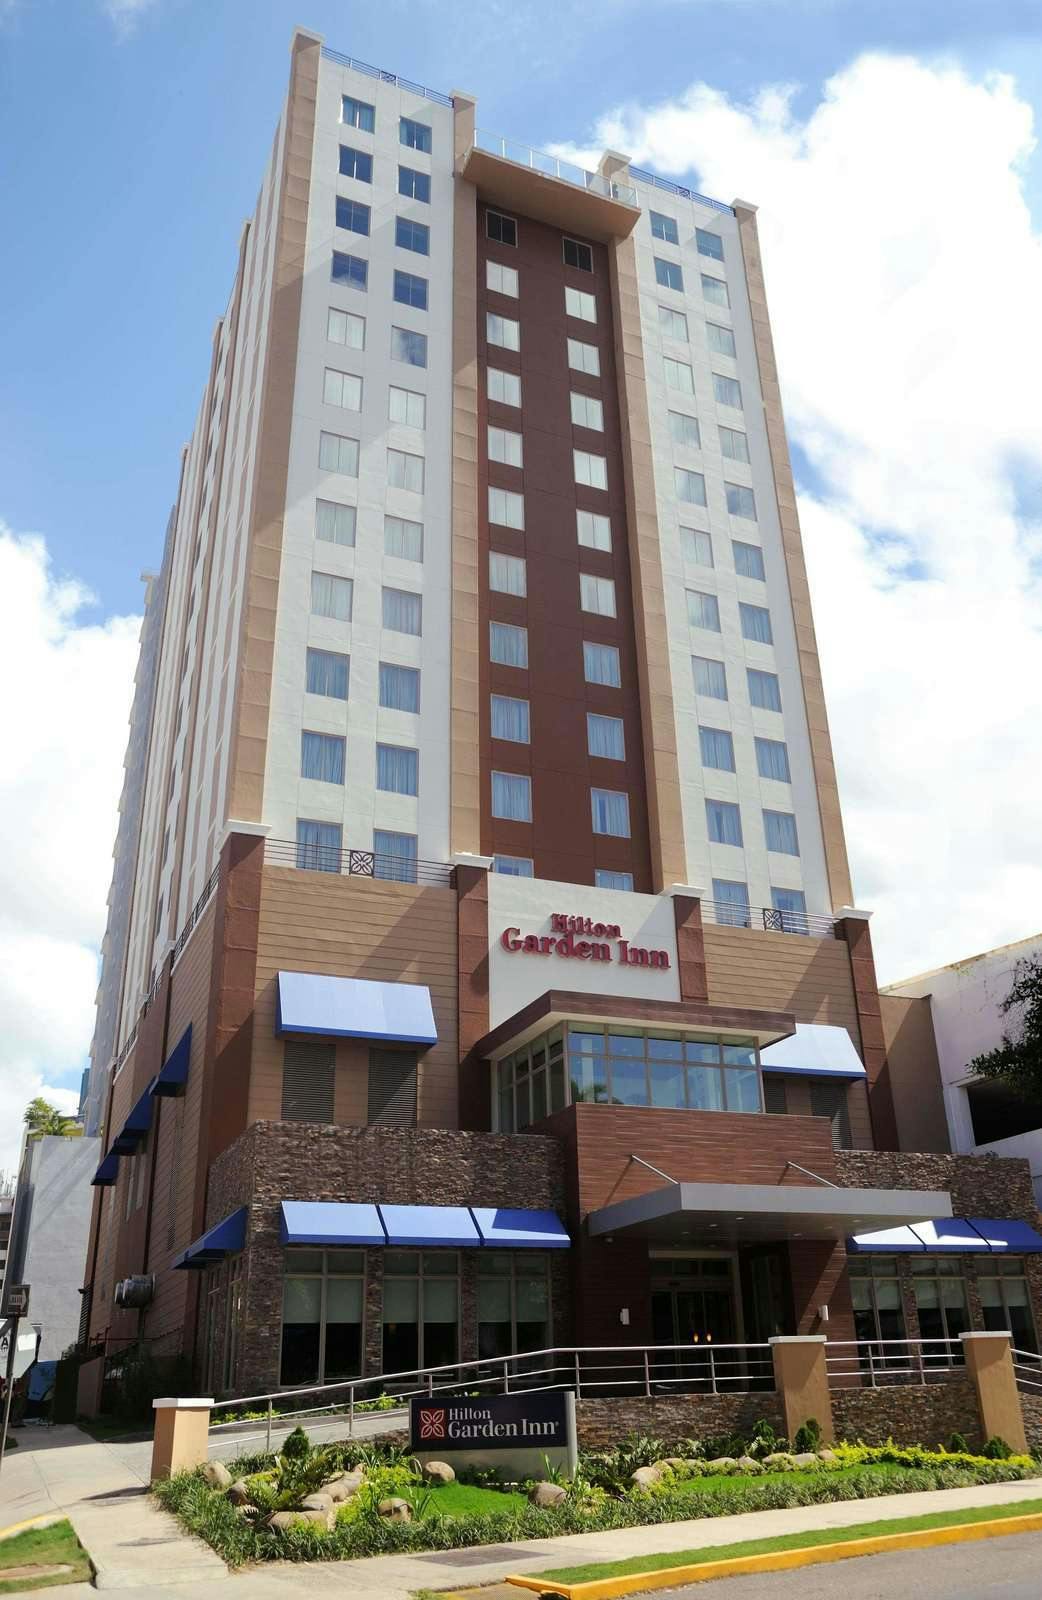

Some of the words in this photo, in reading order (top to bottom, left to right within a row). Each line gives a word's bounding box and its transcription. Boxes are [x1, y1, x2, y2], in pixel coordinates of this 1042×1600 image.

[551, 913, 622, 939] Hilton
[500, 927, 612, 962] Garden
[617, 940, 671, 969] Inn
[449, 1407, 491, 1421] Hilton
[448, 1419, 518, 1439] Garden
[521, 1418, 557, 1436] Inn
